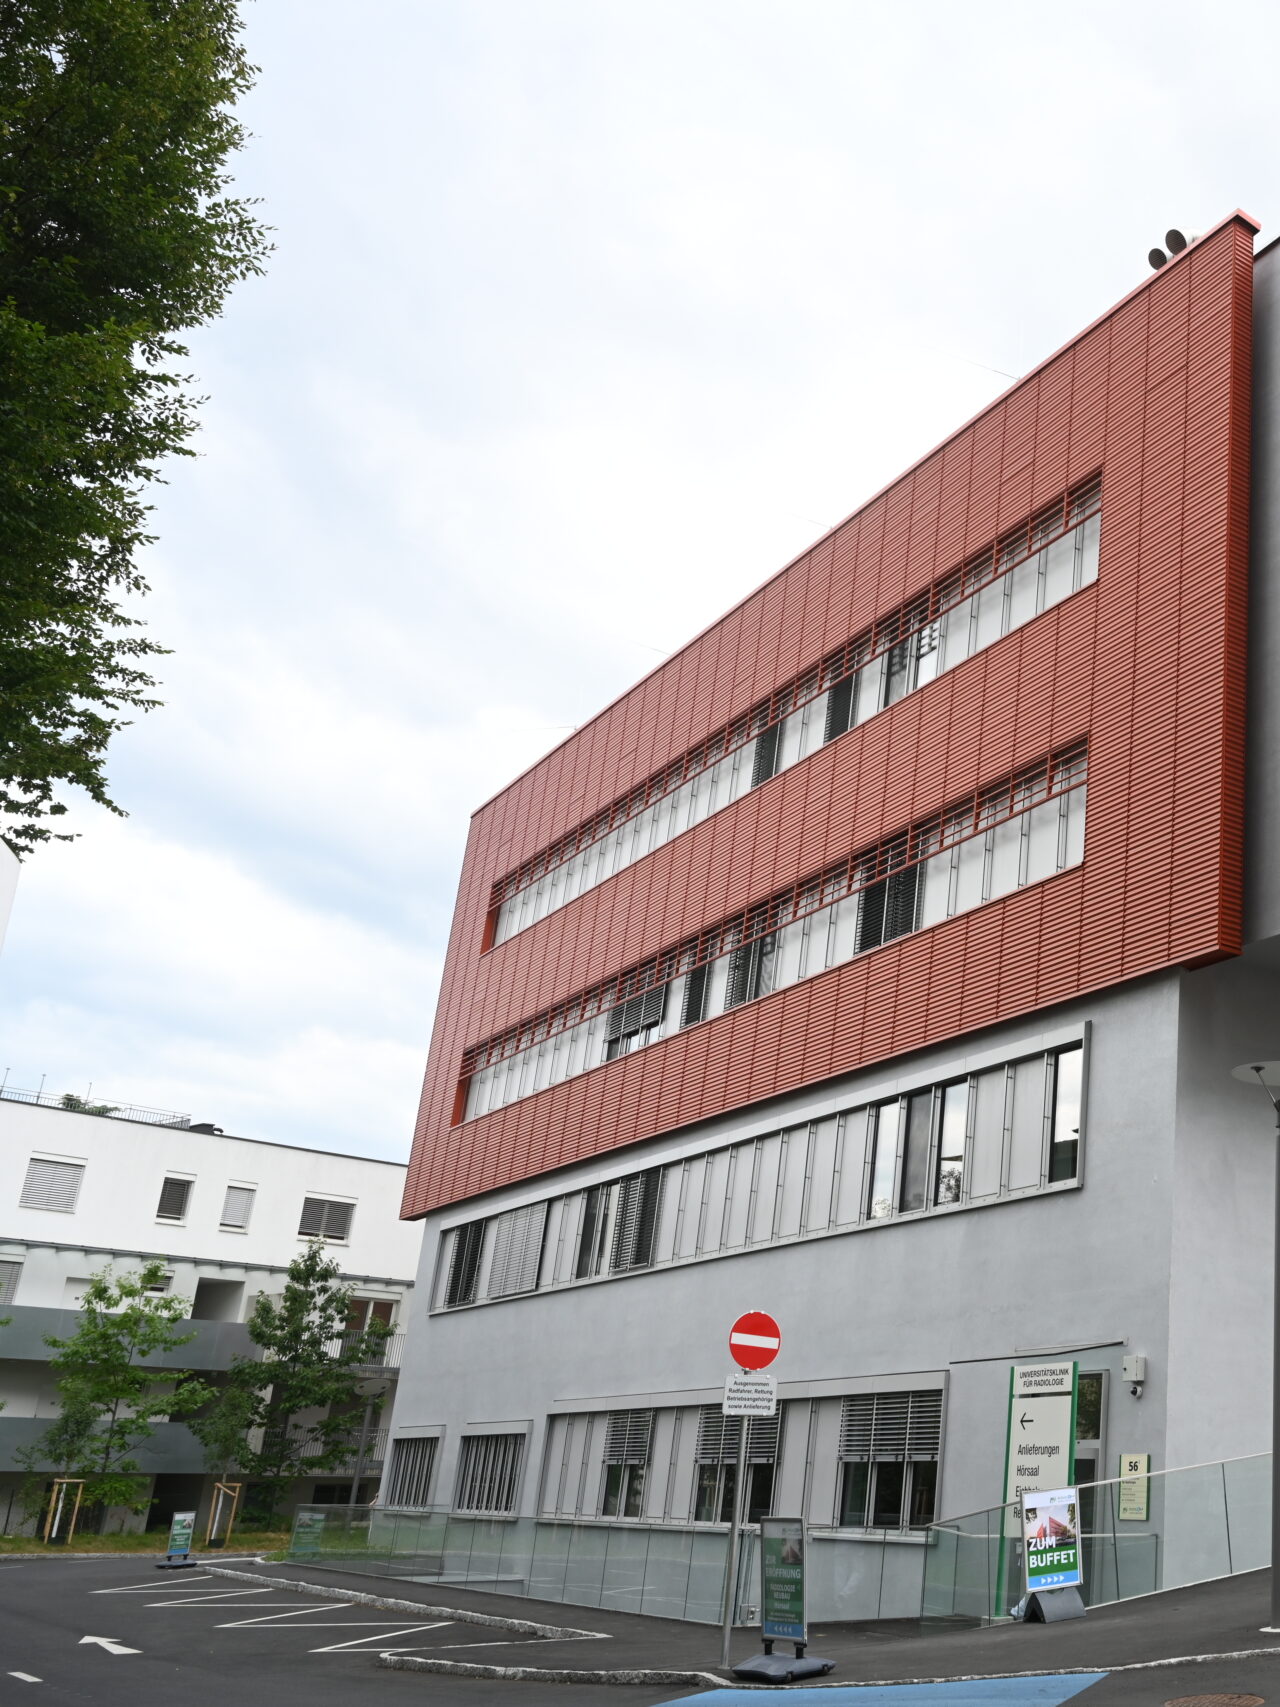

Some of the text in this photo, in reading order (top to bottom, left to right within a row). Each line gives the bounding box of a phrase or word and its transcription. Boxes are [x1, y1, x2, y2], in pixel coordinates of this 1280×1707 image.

[1019, 1368, 1070, 1379] UNIVERSITÄTSKLINIK
[1023, 1377, 1064, 1388] FÜR RADIOLOGIE
[1017, 1444, 1060, 1457] Anlieferungen
[1016, 1465, 1040, 1477] Hörsaal
[1128, 1461, 1139, 1472] 56
[1029, 1536, 1056, 1551] ZUM
[1029, 1549, 1075, 1569] BUFFET
